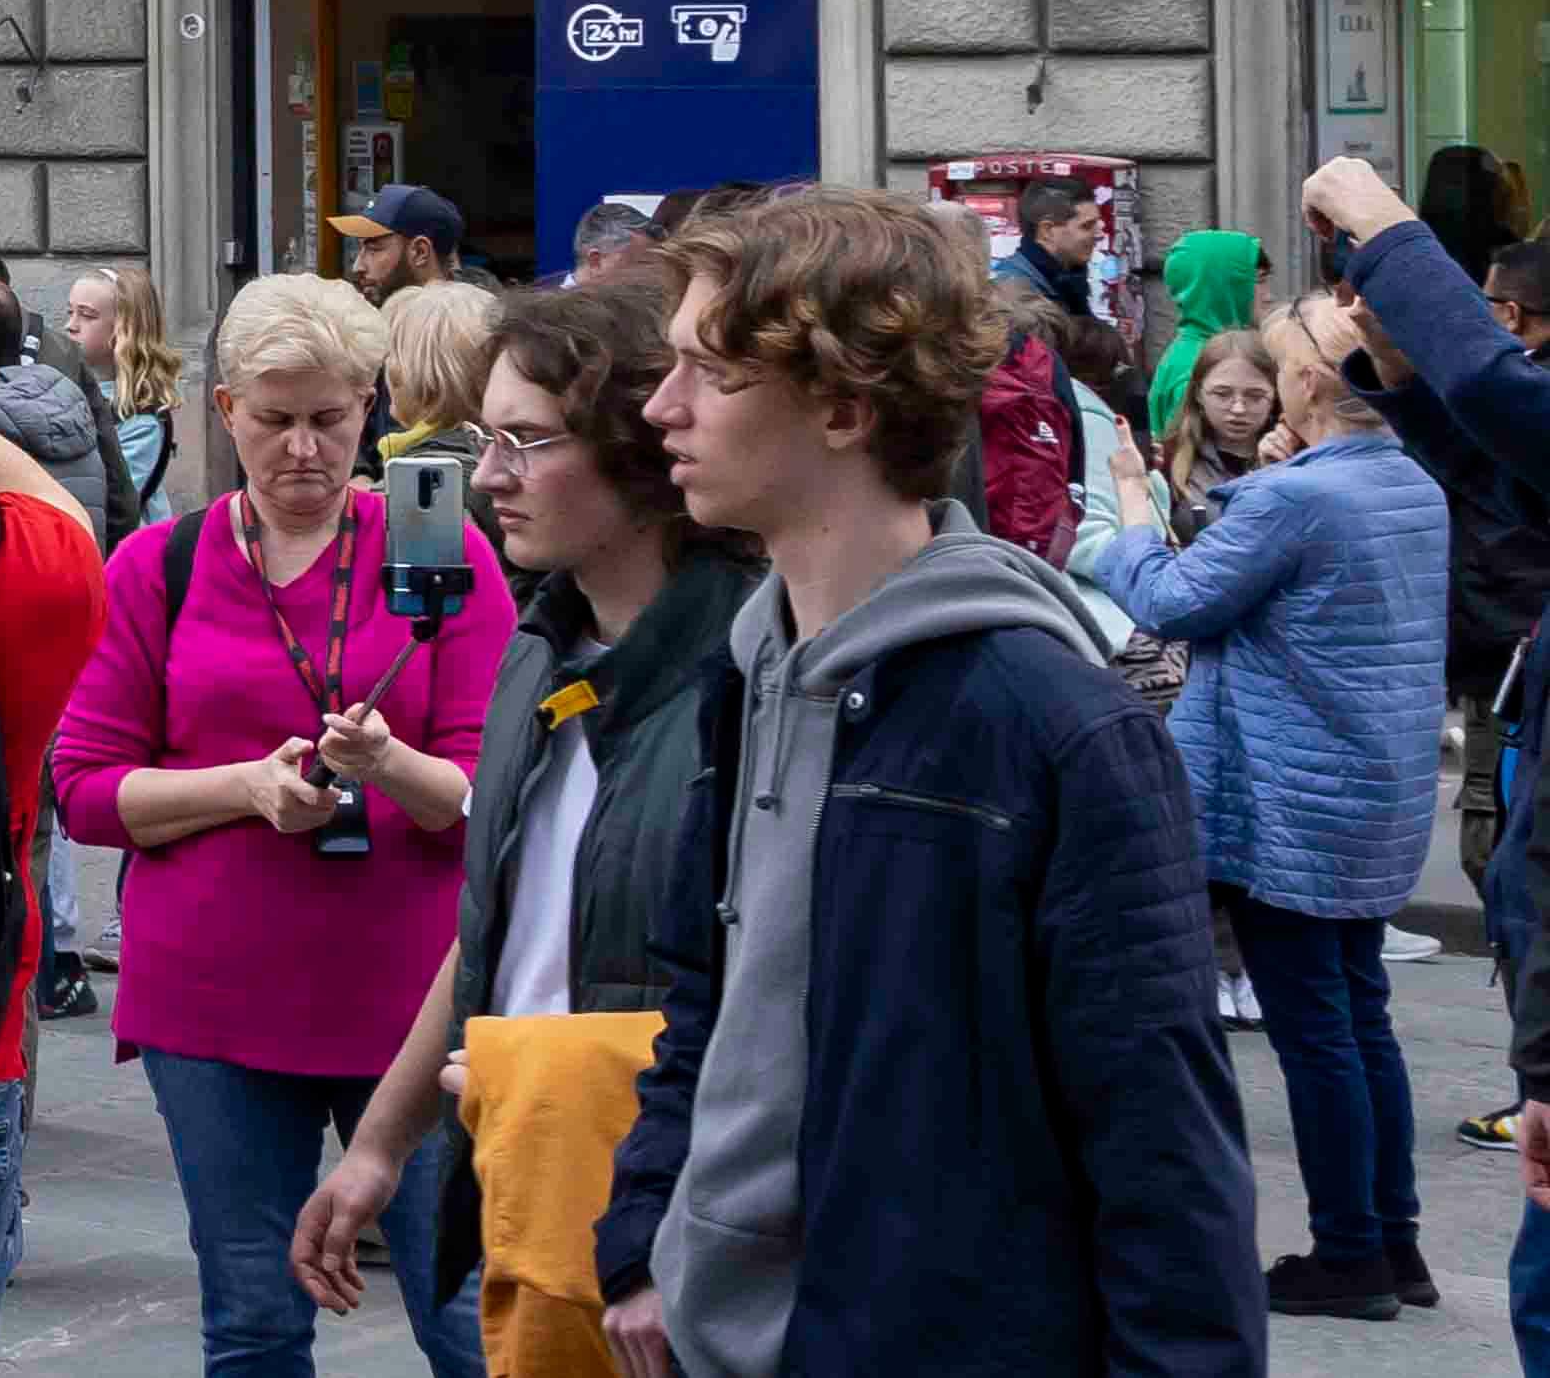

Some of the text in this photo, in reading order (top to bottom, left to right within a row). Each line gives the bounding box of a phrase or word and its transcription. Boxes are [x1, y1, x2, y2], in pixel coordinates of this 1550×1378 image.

[588, 24, 639, 41] 24 hr
[974, 159, 1054, 175] POSTE
